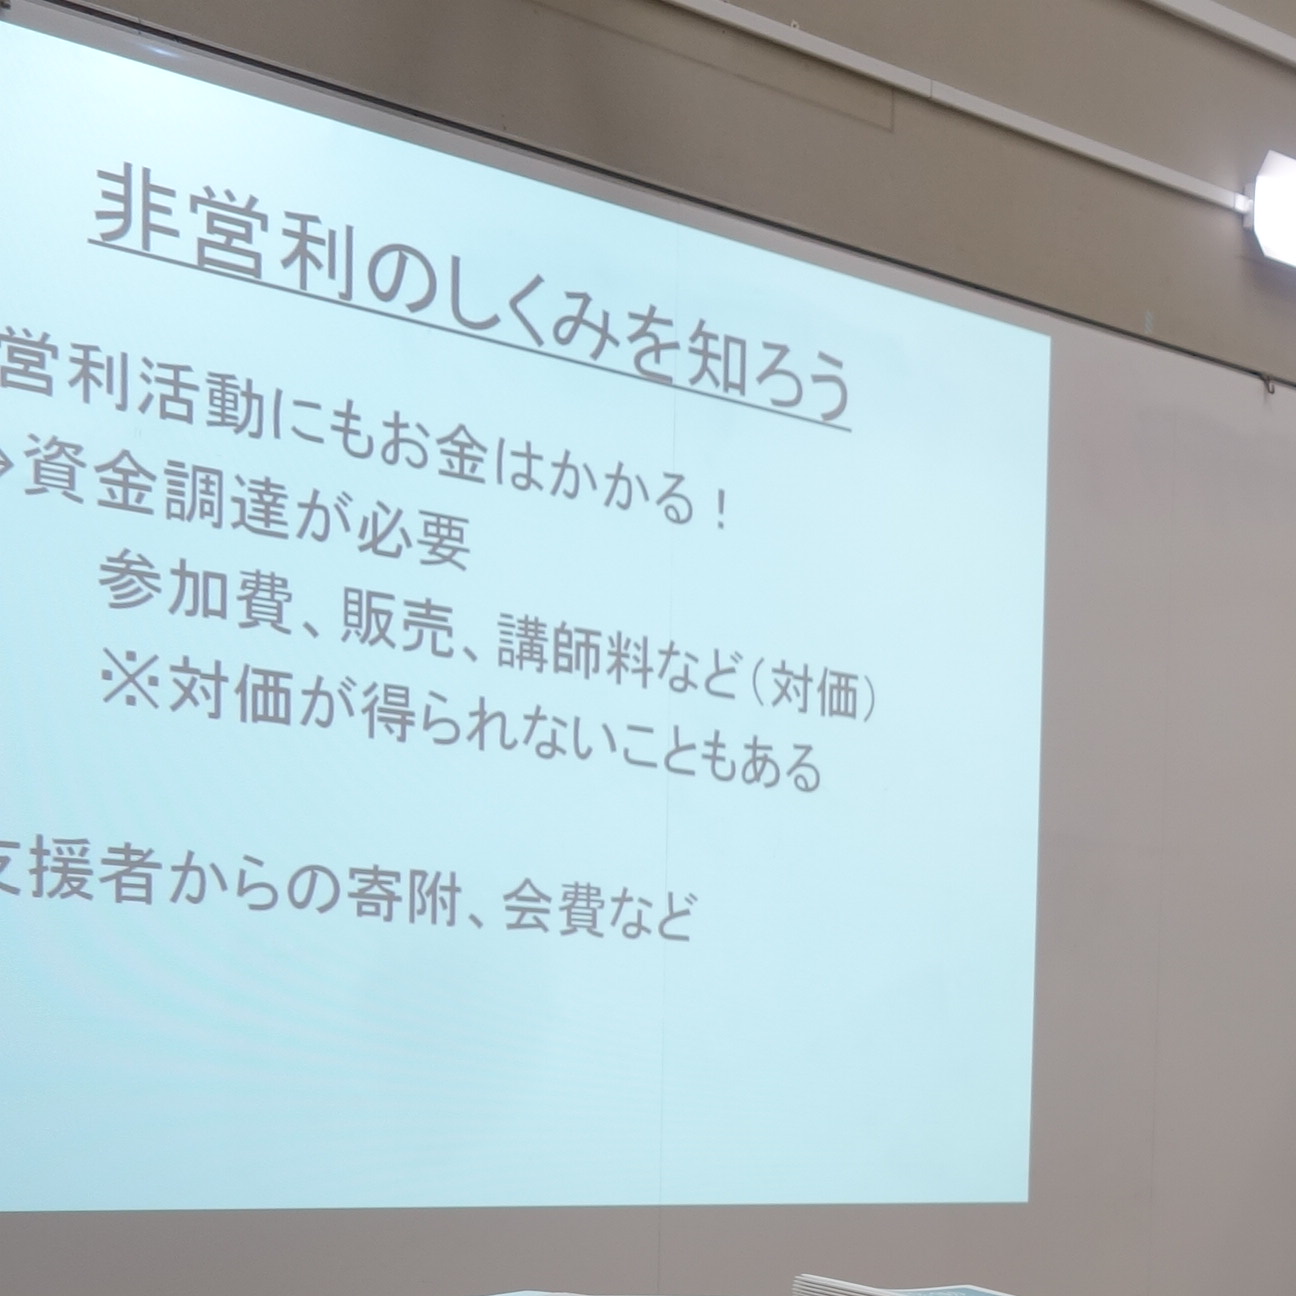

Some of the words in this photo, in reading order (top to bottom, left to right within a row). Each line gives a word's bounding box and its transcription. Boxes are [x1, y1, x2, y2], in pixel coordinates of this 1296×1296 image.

[92, 160, 852, 424] 非営利のしくみを知ろう
[98, 546, 878, 724] 参加費、販売、講師料など（対価）
[100, 646, 824, 795] ※対価が得られないこともある
